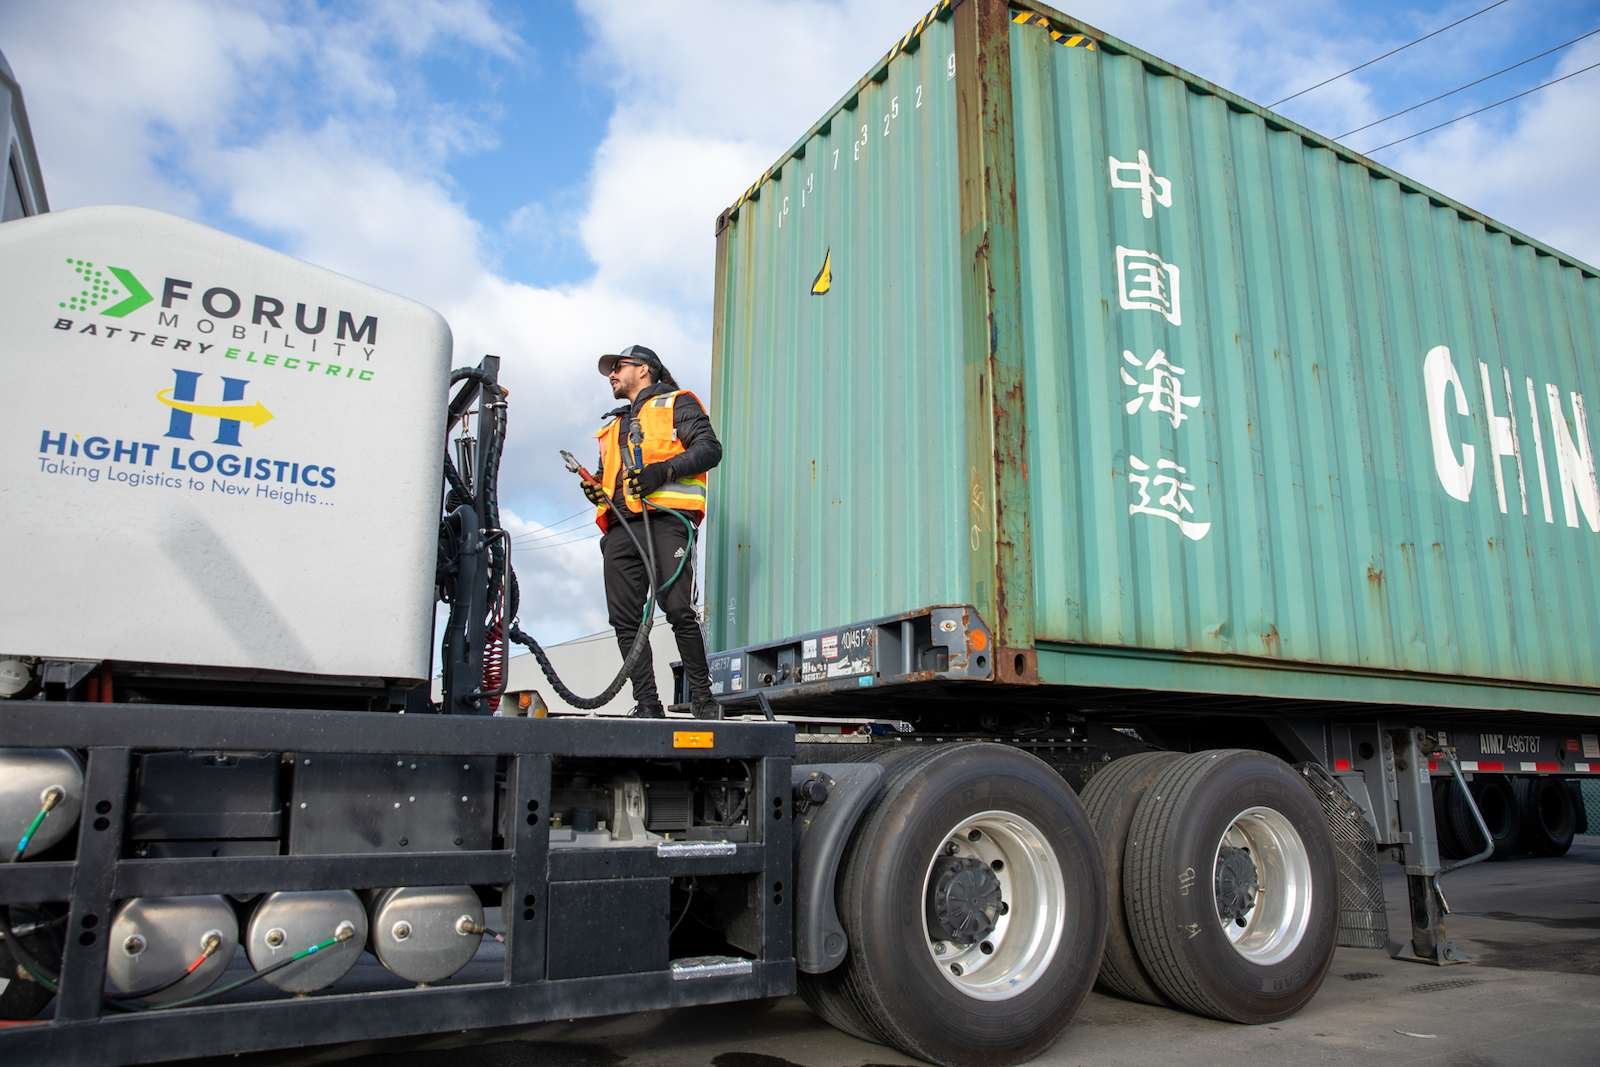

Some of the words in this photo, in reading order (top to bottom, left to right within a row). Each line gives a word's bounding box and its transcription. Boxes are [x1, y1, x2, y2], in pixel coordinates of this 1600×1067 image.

[158, 311, 375, 361] MOBILITY
[161, 277, 378, 345] FORUM
[54, 318, 214, 354] BATTERY
[225, 348, 374, 381] ELECTRIC
[1109, 149, 1211, 541] 中国海运
[38, 457, 100, 482] Taking
[108, 466, 182, 488] Logistics
[187, 477, 205, 491] to
[212, 478, 250, 496] New
[170, 447, 336, 488] LOGISTICS
[1480, 733, 1505, 754] AIMZ
[1507, 735, 1541, 753] 496787
